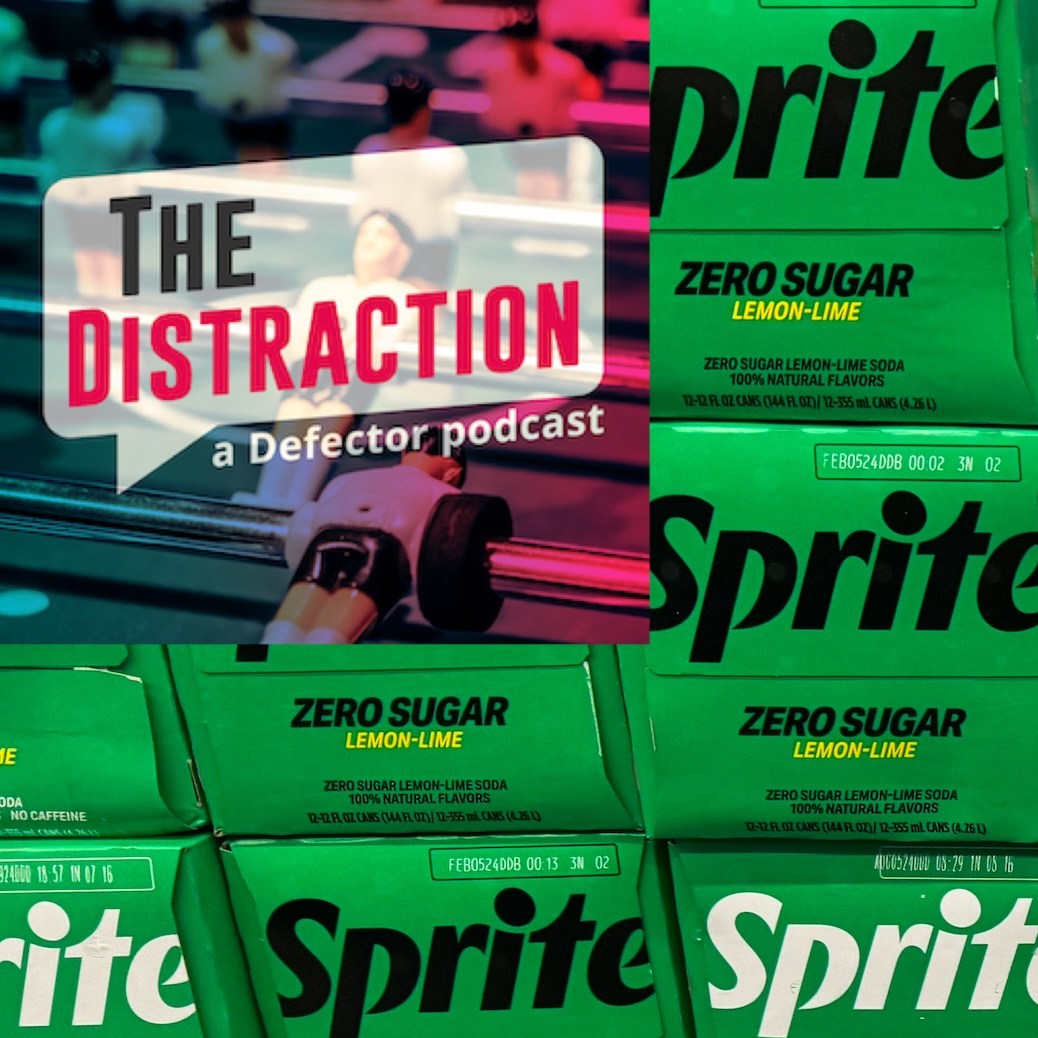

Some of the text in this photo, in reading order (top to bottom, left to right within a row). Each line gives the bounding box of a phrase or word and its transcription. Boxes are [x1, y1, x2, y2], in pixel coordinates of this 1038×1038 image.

[650, 19, 1005, 218] prite
[675, 261, 914, 298] ZERO SUGAR
[732, 301, 862, 321] LEMON-LIME
[704, 357, 905, 372] ZERO SUGAR LEMON-LIME SODA
[730, 373, 885, 387] 100% NATURAL FLAVORS
[985, 456, 1001, 473] 02
[291, 696, 509, 728] ZERO SUGAR
[738, 706, 966, 738] ZERO SUGAR
[345, 731, 463, 750] LEMON-LIME
[792, 741, 918, 759] LEMON-LIME
[570, 857, 585, 870] 3N
[595, 856, 610, 869] 02
